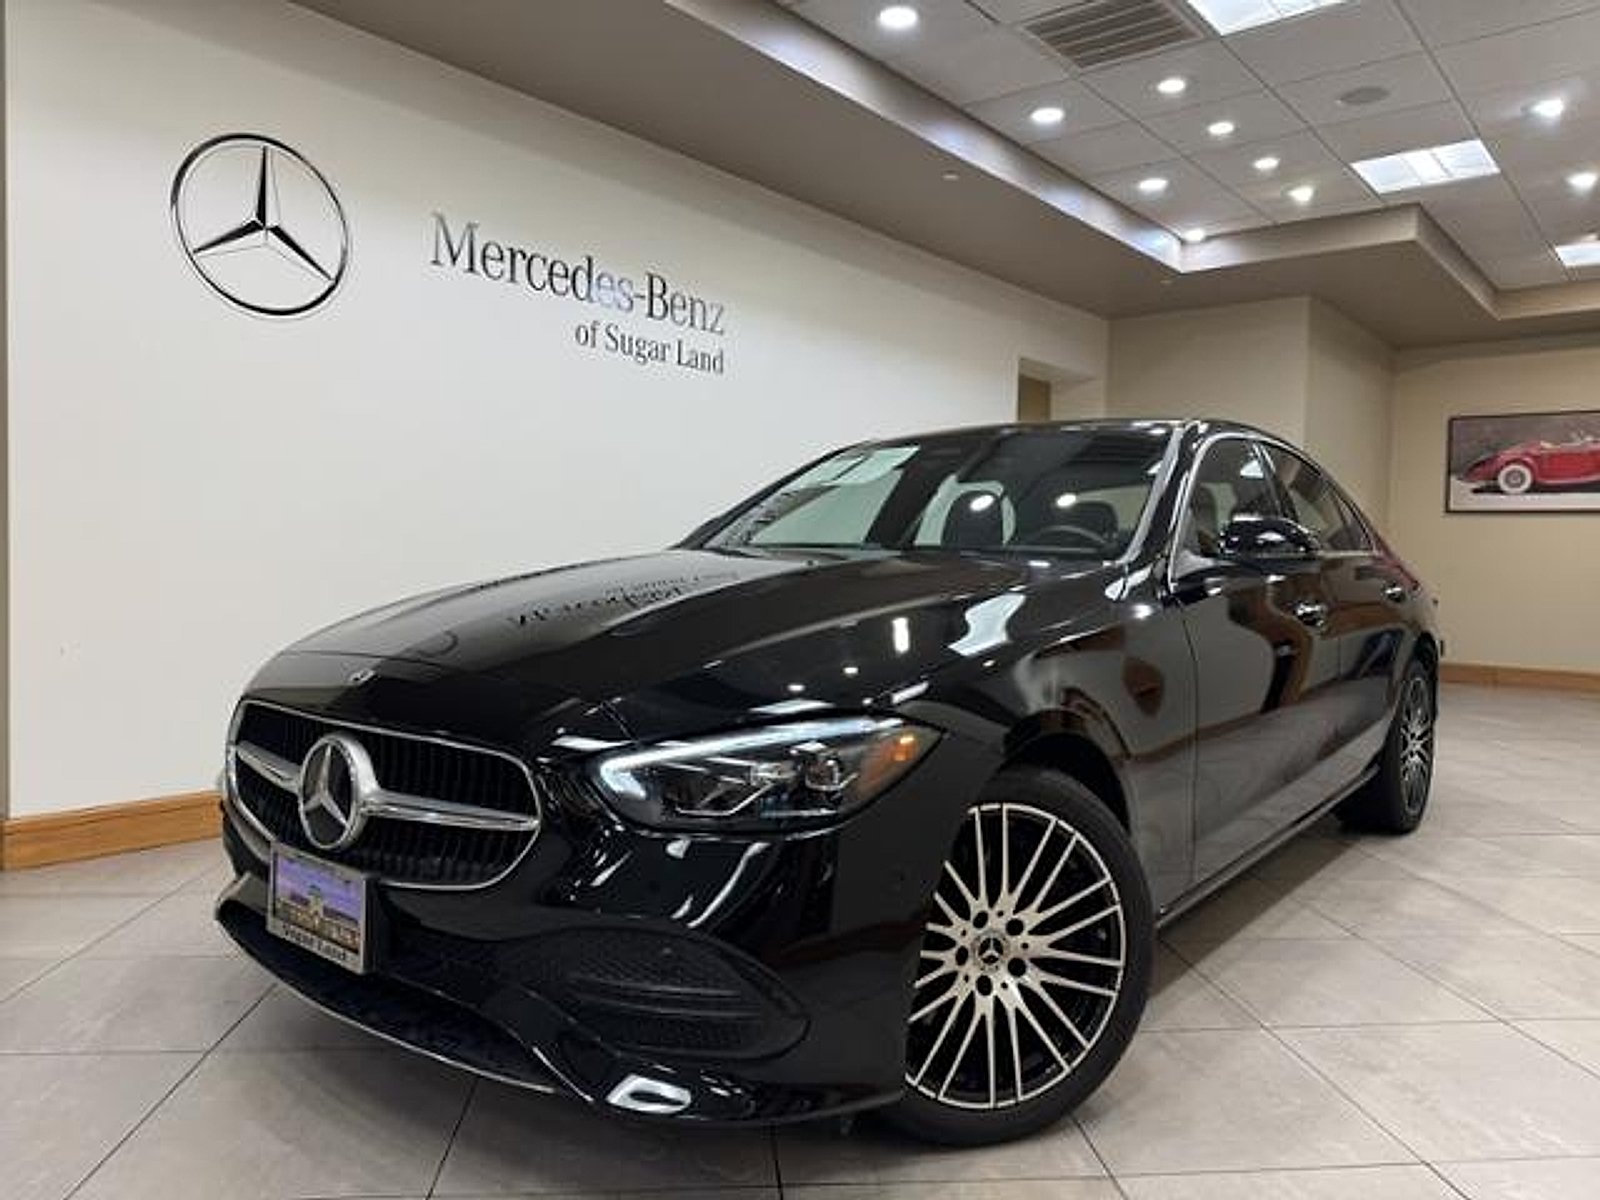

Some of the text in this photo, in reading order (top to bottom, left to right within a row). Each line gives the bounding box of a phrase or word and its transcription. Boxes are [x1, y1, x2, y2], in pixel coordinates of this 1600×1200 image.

[430, 210, 726, 336] Mercedes-Benz
[575, 320, 724, 374] of Sugar Land
